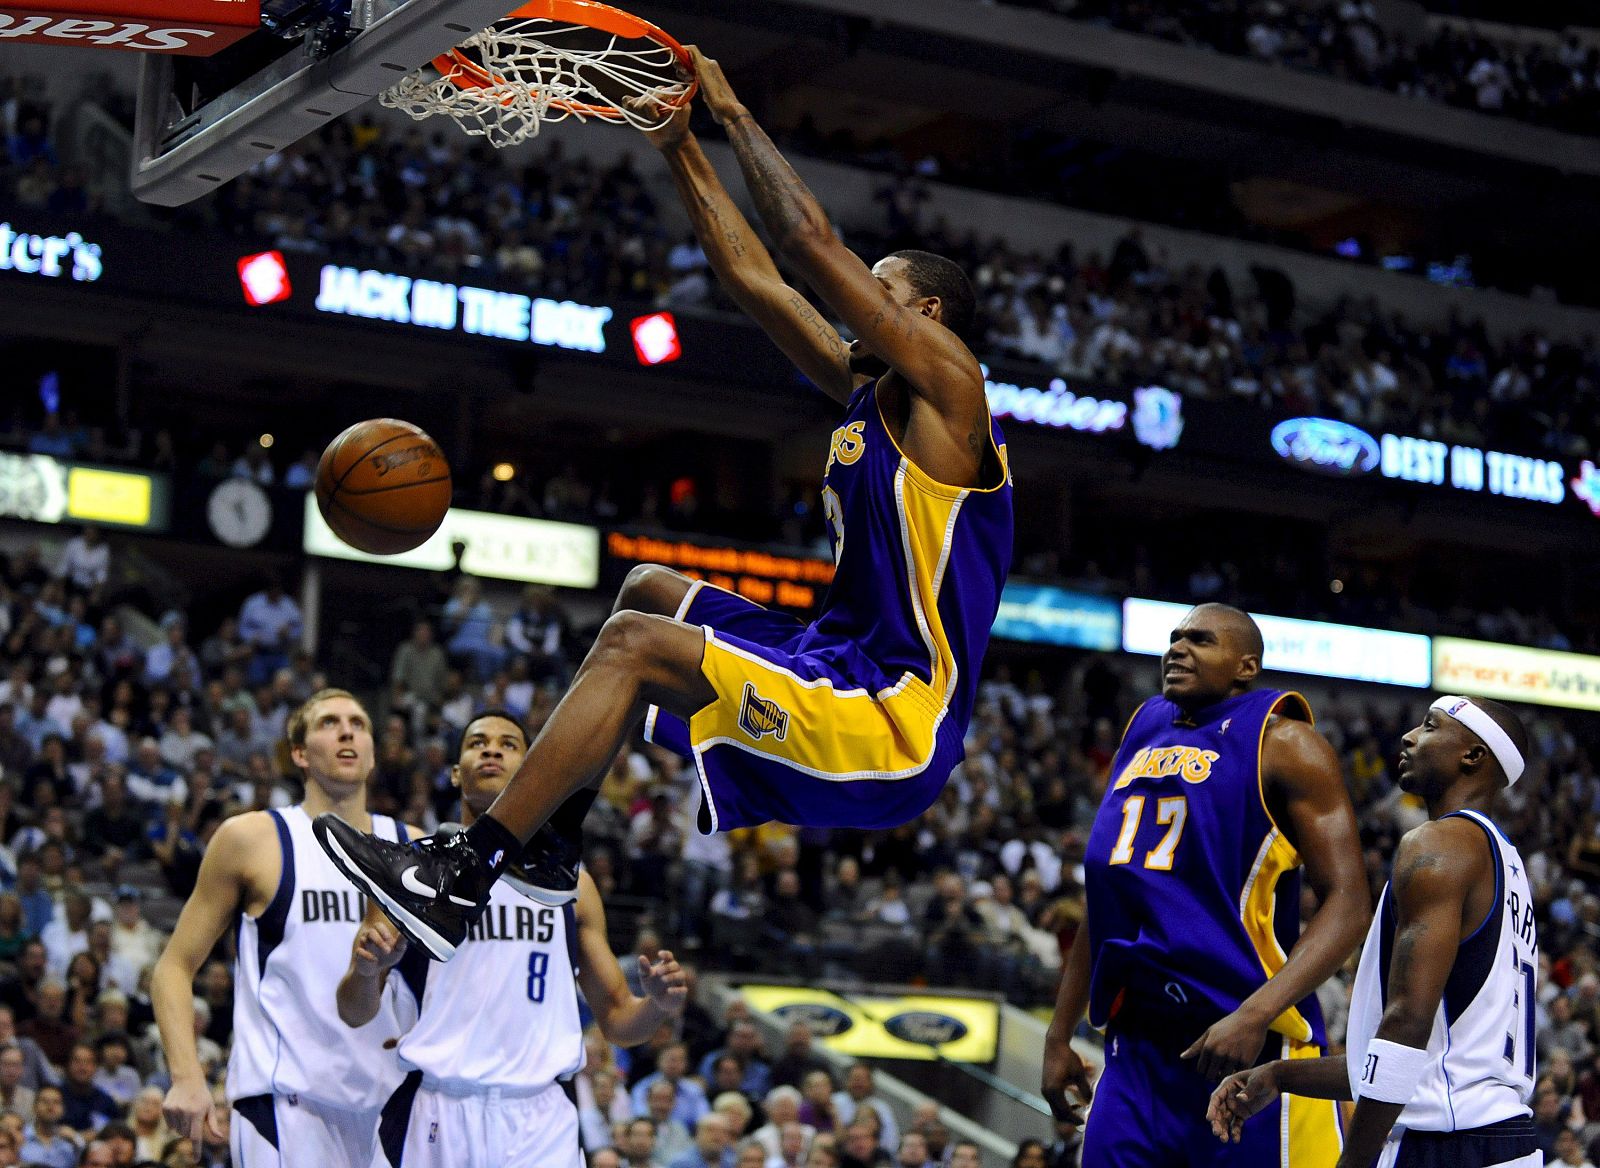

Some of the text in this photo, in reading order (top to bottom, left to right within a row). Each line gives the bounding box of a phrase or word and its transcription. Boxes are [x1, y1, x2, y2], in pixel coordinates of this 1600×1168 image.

[0, 13, 215, 50] Stat
[315, 264, 613, 354] JACK IN THE BOX
[1381, 433, 1566, 504] BEST IN TEXAS
[1108, 795, 1188, 871] 17
[301, 889, 367, 923] DALL
[467, 904, 556, 944] ALLAS
[526, 950, 550, 1005] 8
[1361, 1053, 1379, 1085] 31
